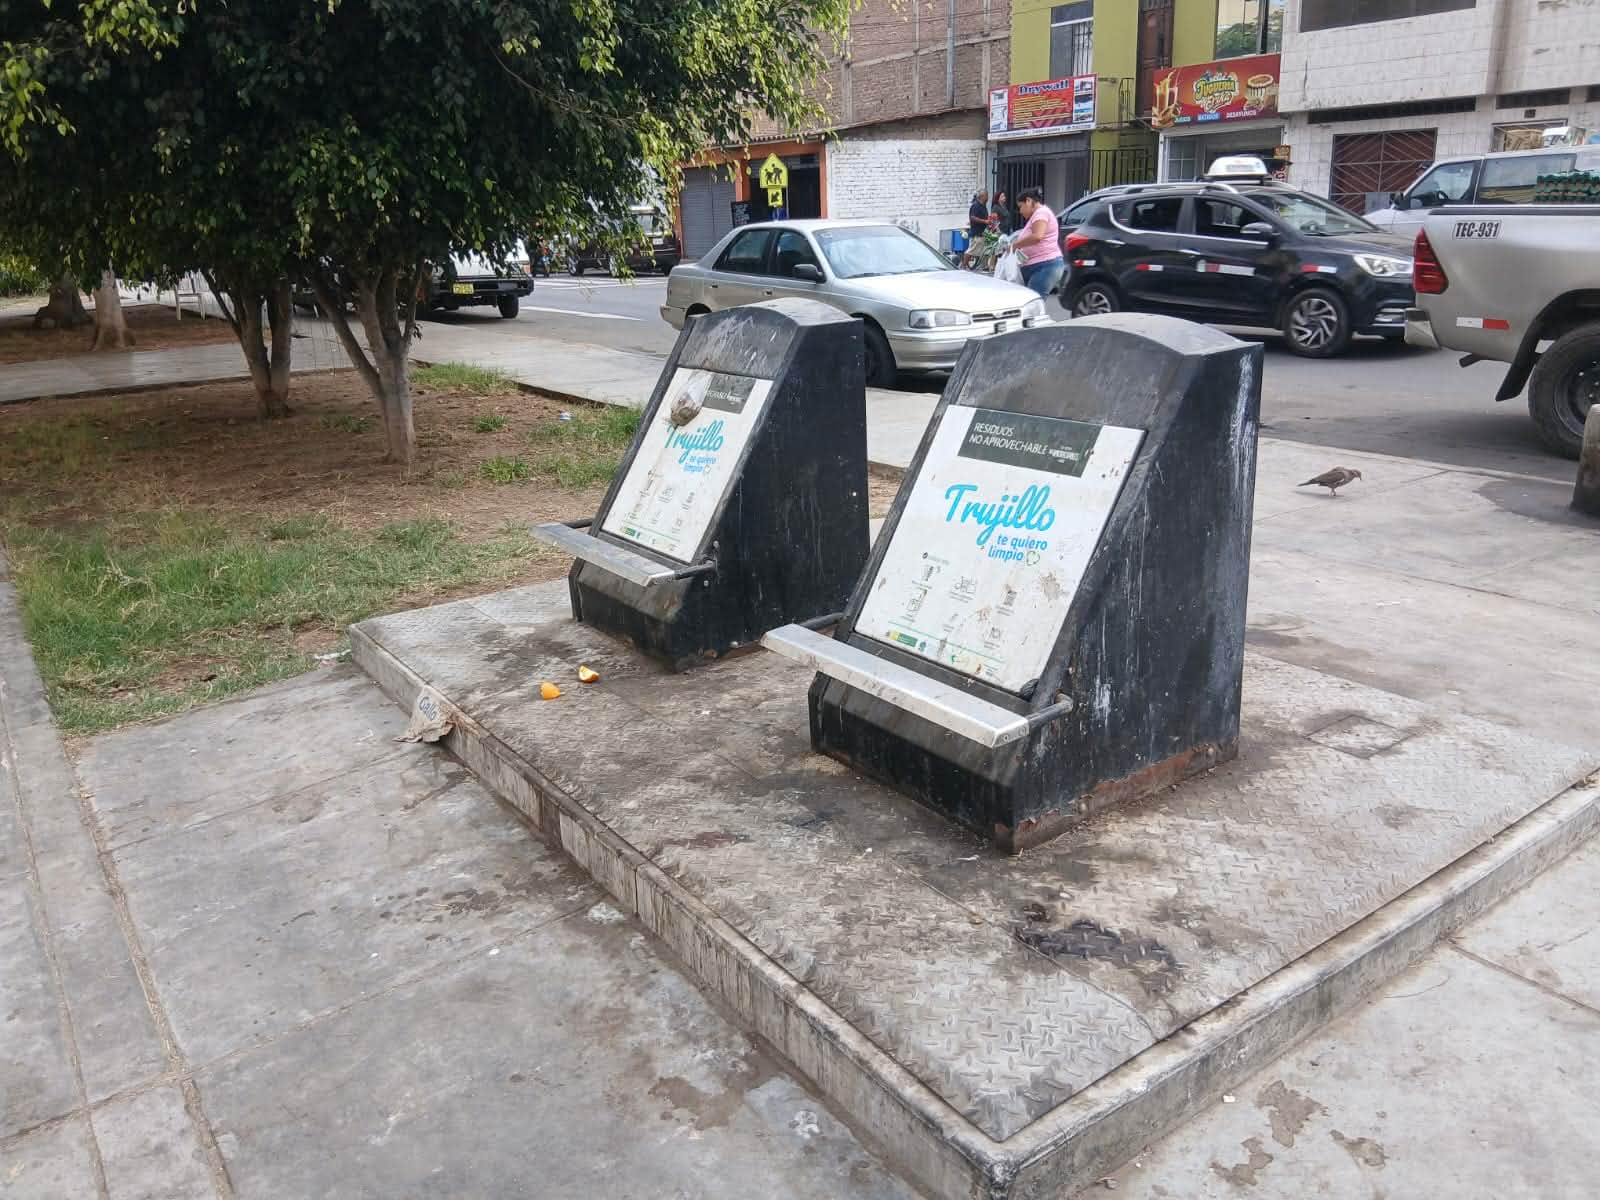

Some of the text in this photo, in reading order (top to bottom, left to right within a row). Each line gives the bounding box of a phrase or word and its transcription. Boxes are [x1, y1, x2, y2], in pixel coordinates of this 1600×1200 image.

[1019, 80, 1069, 95] Drywall
[1455, 222, 1500, 238] TEC-931
[974, 422, 1015, 436] RESIDUOS
[969, 434, 983, 445] NO
[945, 484, 1055, 546] Trujillo
[997, 534, 1048, 551] te quiero
[988, 545, 1025, 562] limpio
